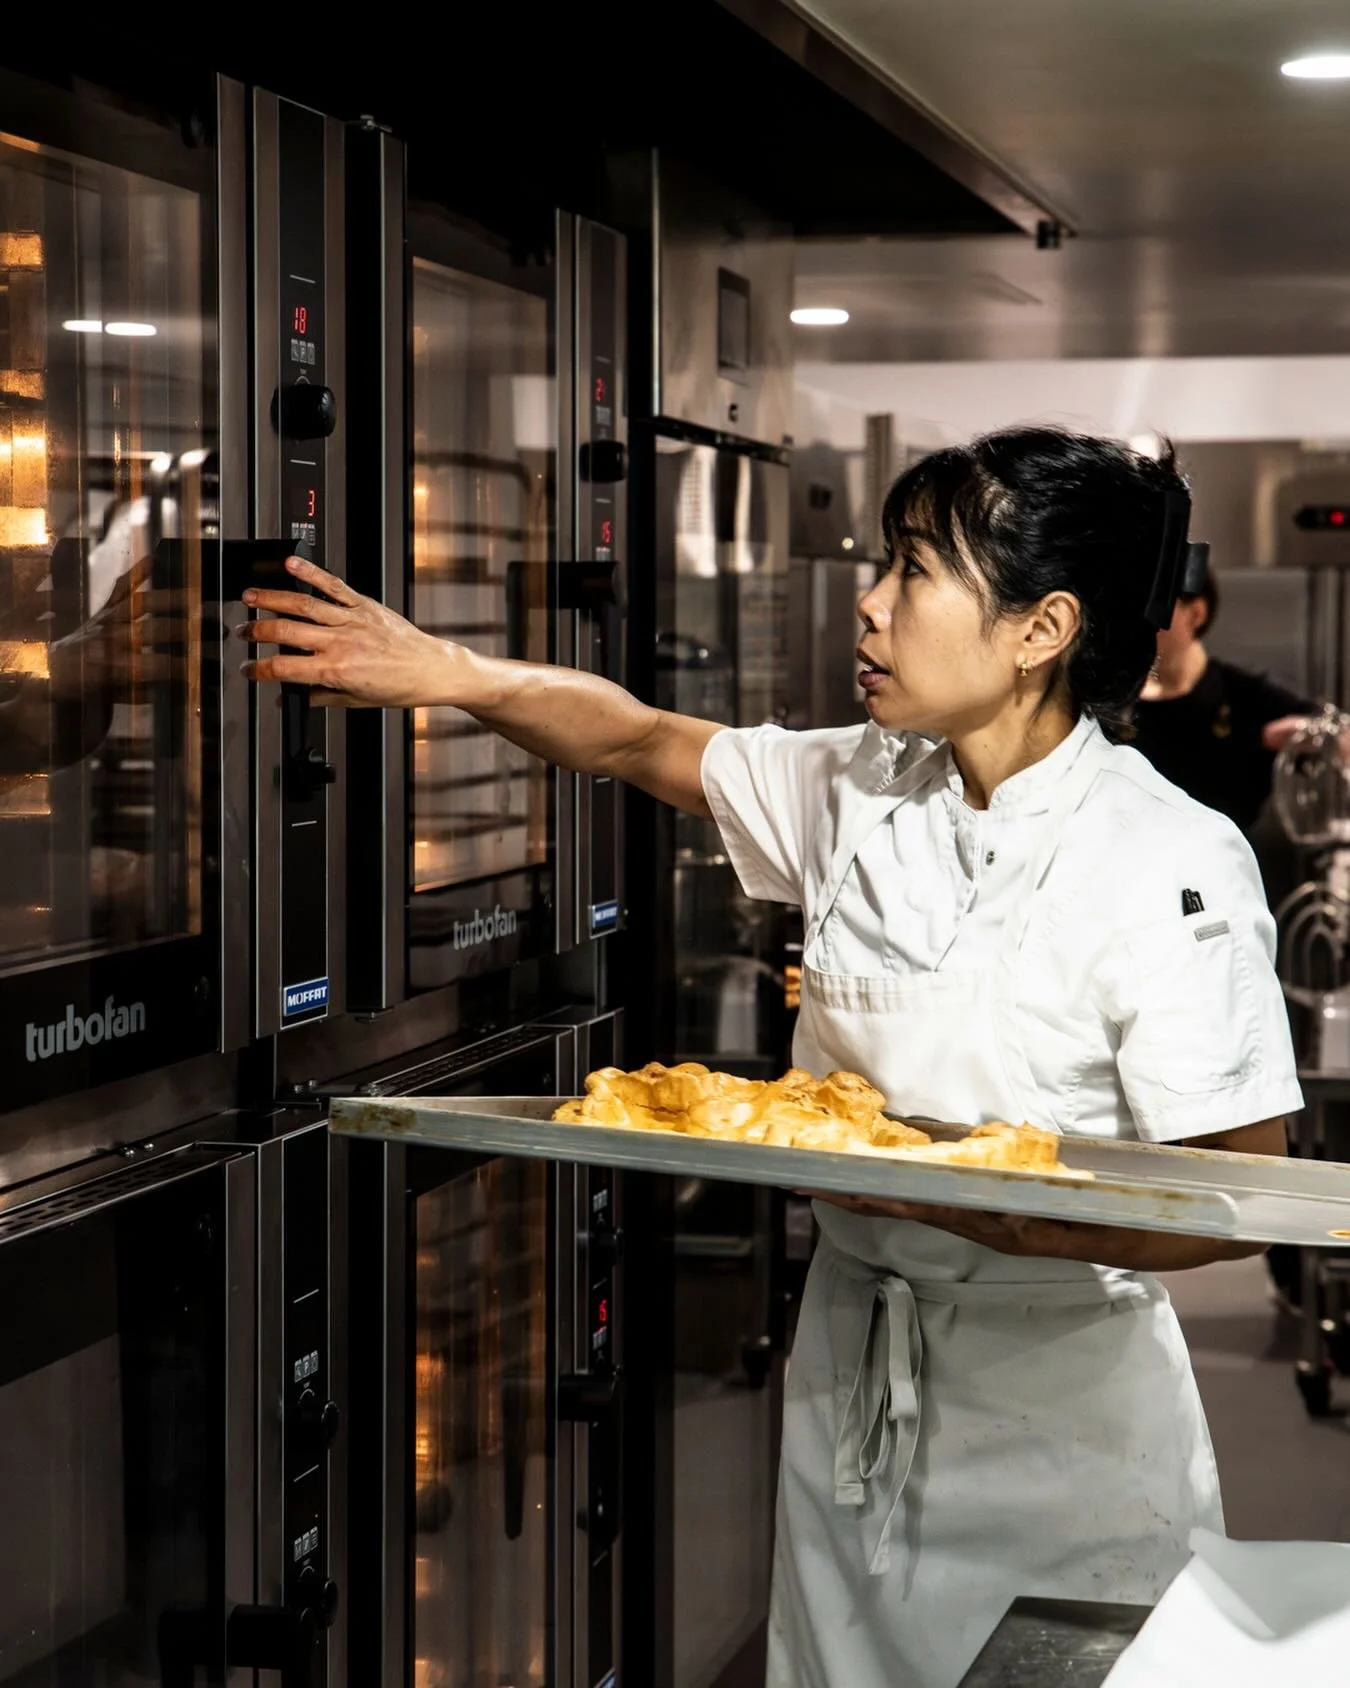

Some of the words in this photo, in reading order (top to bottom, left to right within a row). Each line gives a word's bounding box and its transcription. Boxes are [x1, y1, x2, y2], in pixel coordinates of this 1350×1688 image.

[295, 306, 307, 334] 18
[308, 490, 315, 516] 3
[453, 904, 516, 950] turbofan
[288, 985, 328, 1007] MOFFAT
[26, 995, 145, 1062] turbofan
